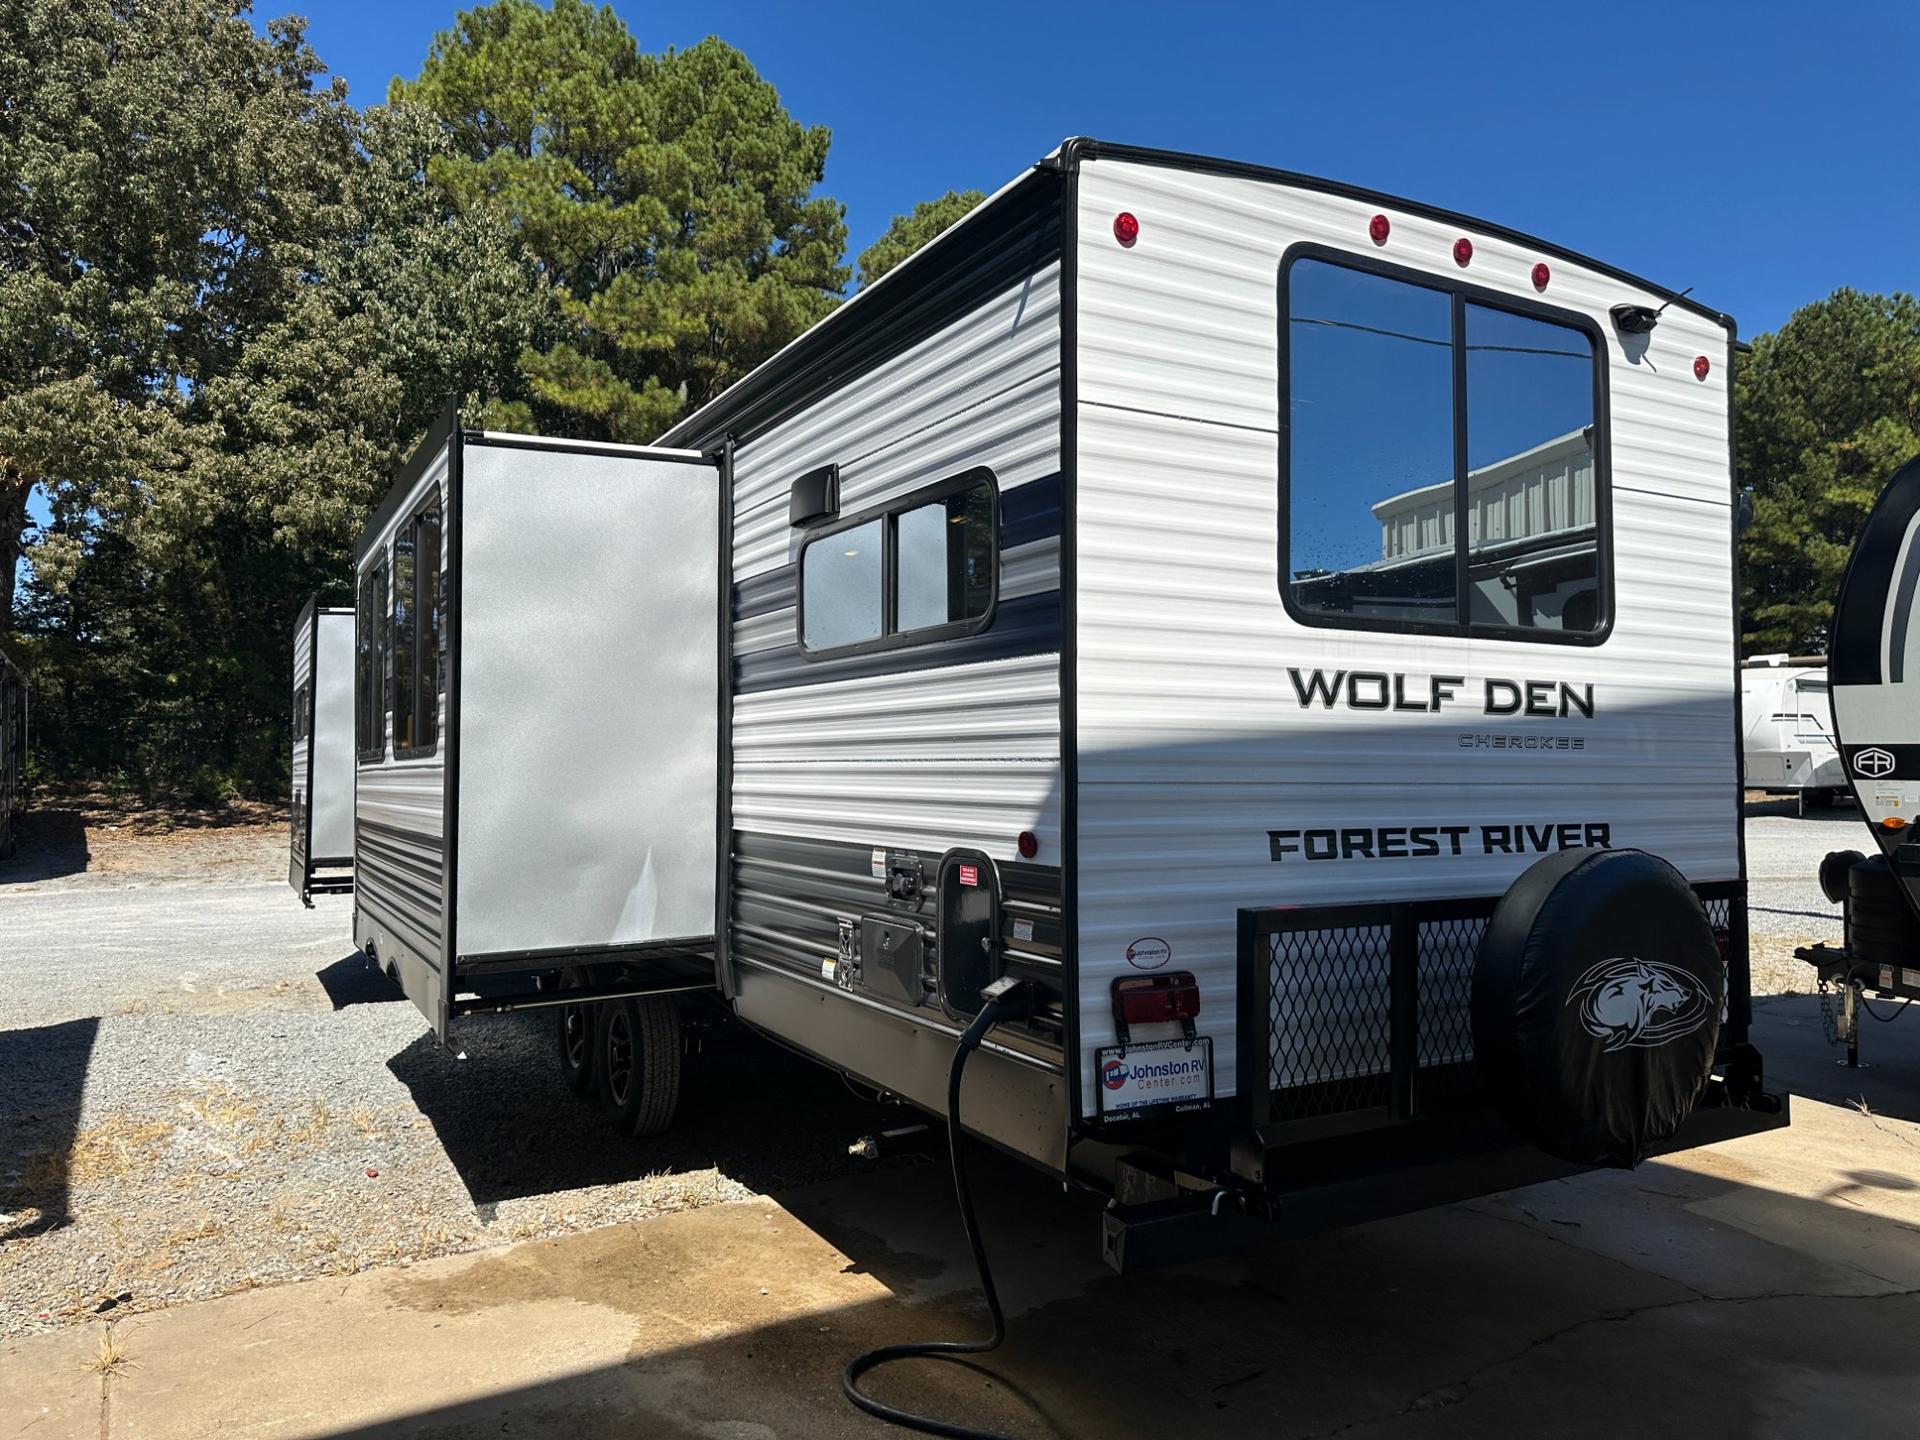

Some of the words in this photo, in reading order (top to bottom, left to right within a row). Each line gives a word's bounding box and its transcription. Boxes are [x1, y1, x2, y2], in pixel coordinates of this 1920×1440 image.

[1286, 667, 1465, 713] WOLF
[1483, 678, 1594, 718] DEN
[1458, 734, 1585, 750] CHEROKEE
[1266, 826, 1470, 862] FOREST
[1480, 823, 1612, 855] RIVER
[1130, 1061, 1189, 1079] Johnston
[1191, 1058, 1205, 1072] RV
[1137, 1074, 1200, 1090] Center.com
